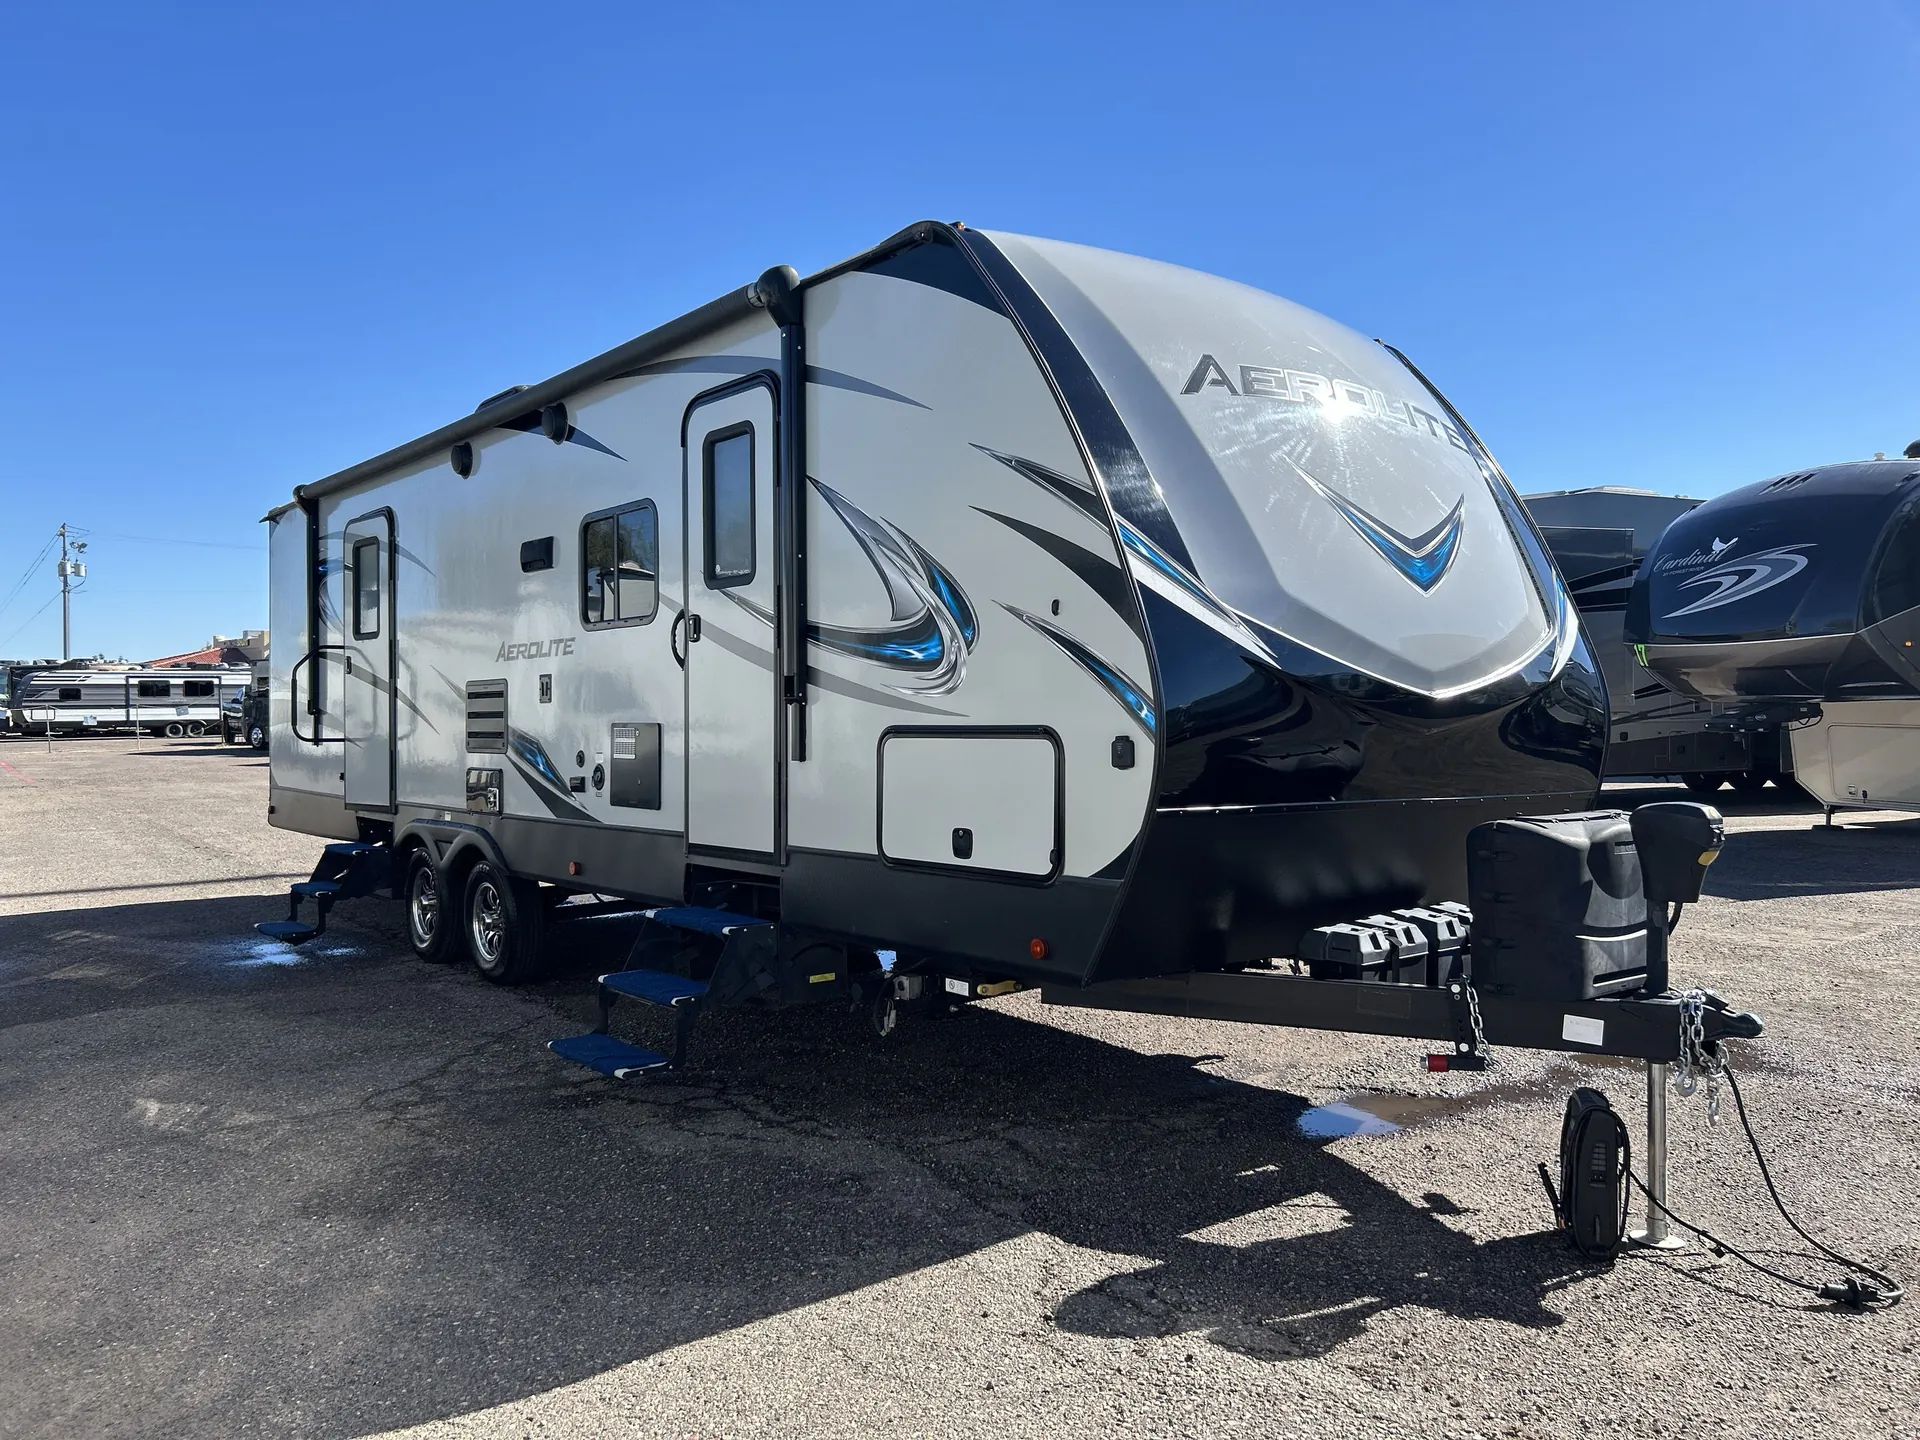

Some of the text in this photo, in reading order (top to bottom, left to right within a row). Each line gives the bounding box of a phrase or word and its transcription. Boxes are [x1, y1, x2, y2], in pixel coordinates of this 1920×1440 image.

[1179, 352, 1470, 456] AEROLITE
[1653, 542, 1736, 573] Cardinal
[495, 636, 577, 663] AEROLITE
